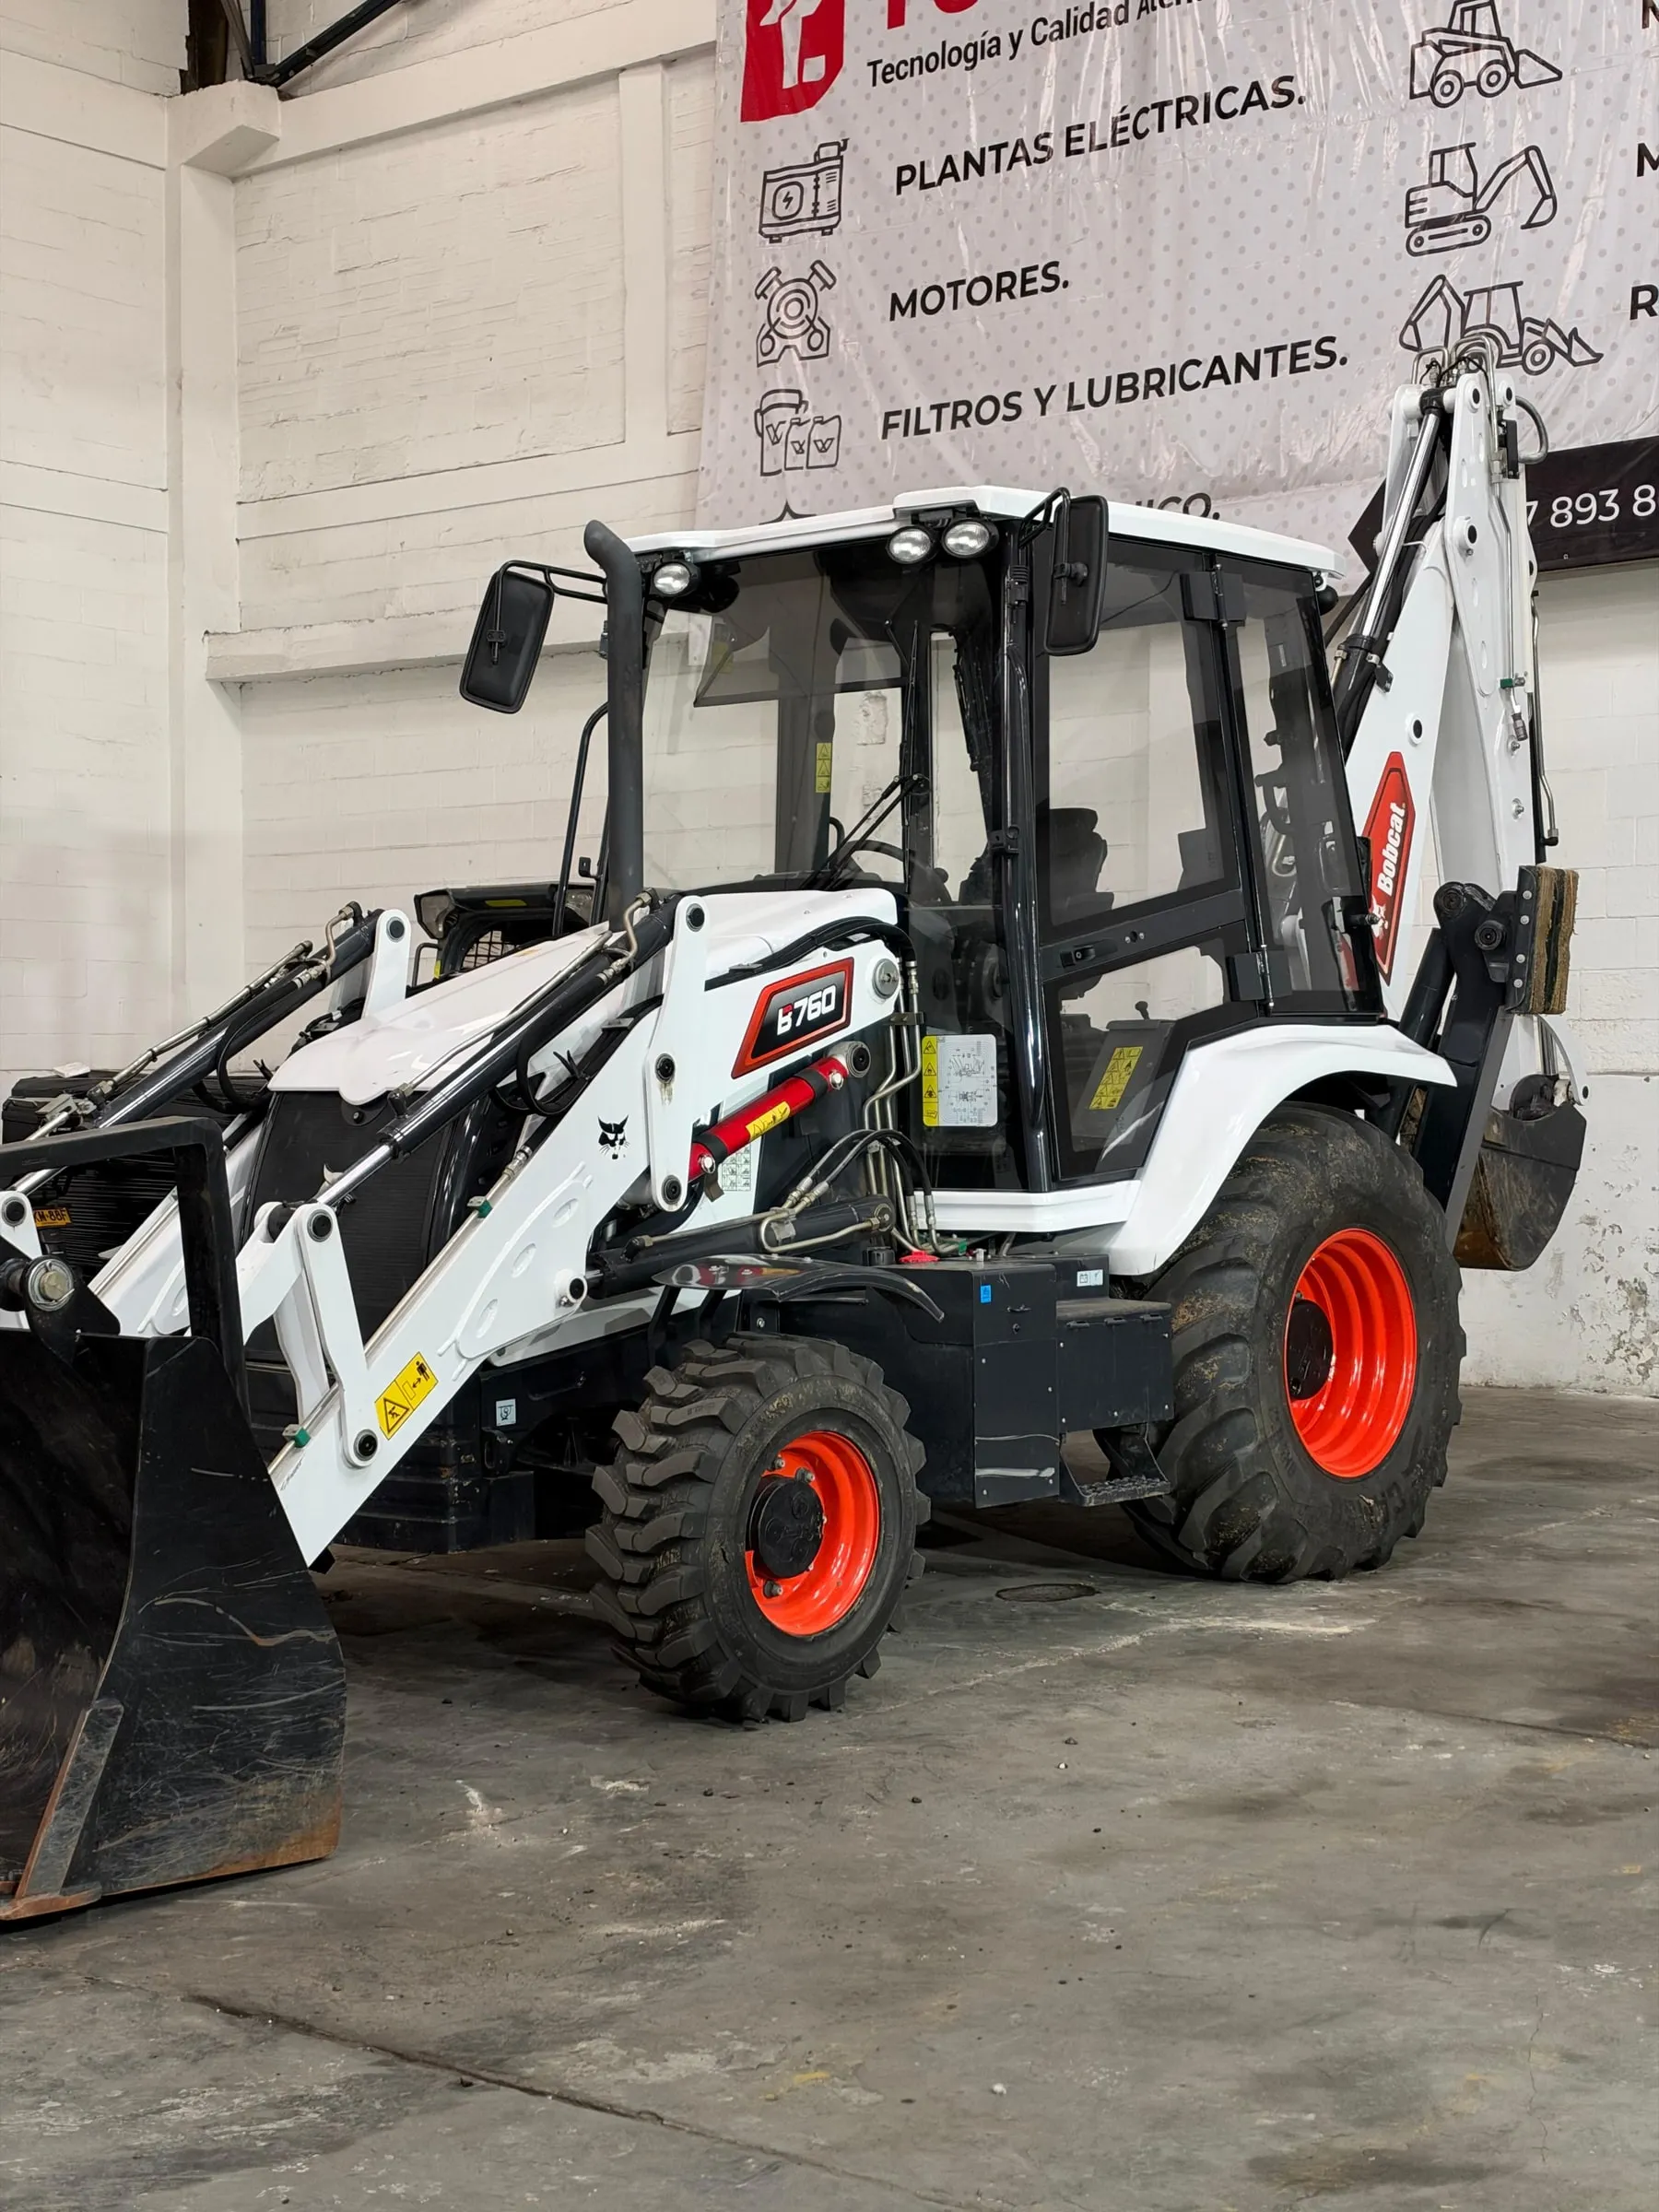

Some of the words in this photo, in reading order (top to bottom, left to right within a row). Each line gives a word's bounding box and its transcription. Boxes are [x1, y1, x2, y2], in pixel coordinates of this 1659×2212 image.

[867, 30, 1001, 88] Tecnología
[1008, 29, 1024, 61] y
[1030, 1, 1130, 46] Calidad
[897, 133, 1054, 196] PLANTAS
[1065, 76, 1304, 157] ELÉCTRICAS.
[890, 261, 1069, 322] MOTORES.
[1630, 284, 1659, 321] R
[882, 391, 1022, 441] FILTROS
[1033, 384, 1057, 417] Y
[1067, 335, 1347, 412] LUBRICANTES.
[1549, 488, 1620, 528] 893
[1632, 484, 1656, 517] 8
[1377, 802, 1406, 896] Bobcat
[777, 984, 837, 1036] B760
